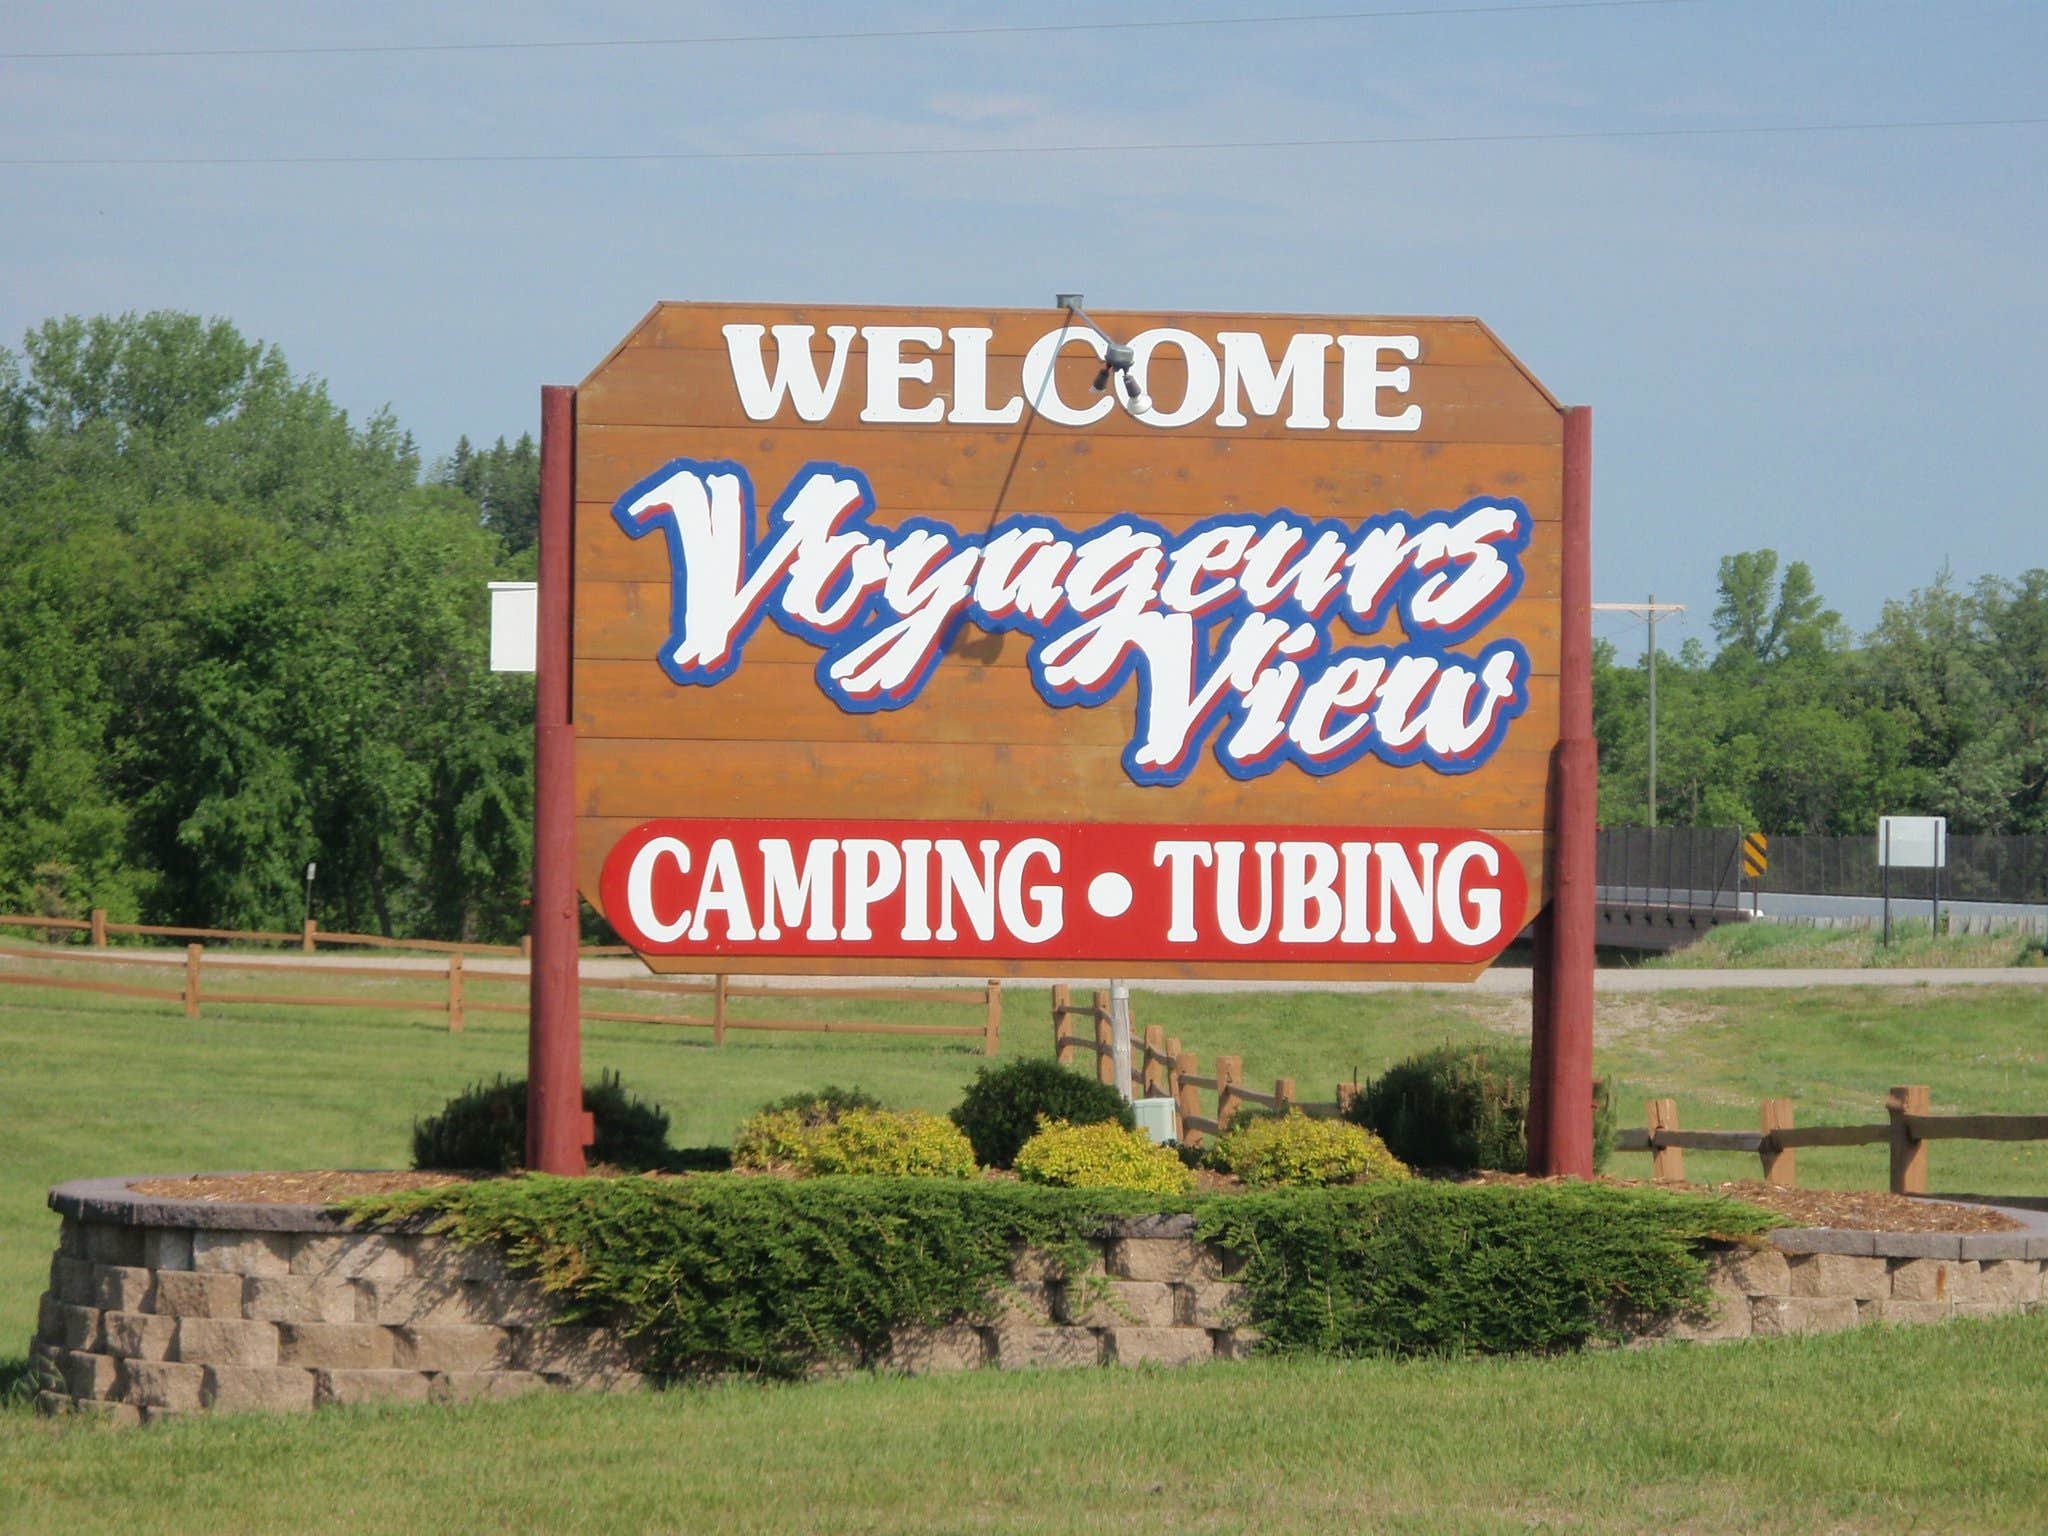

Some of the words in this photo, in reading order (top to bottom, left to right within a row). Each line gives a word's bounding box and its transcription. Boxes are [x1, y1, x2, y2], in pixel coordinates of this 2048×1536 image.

[721, 324, 1423, 431] WELCOME
[627, 471, 1518, 698] Voyageurs
[1130, 611, 1518, 769] View
[627, 836, 1064, 944] CAMPING
[1153, 840, 1502, 946] TUBING
